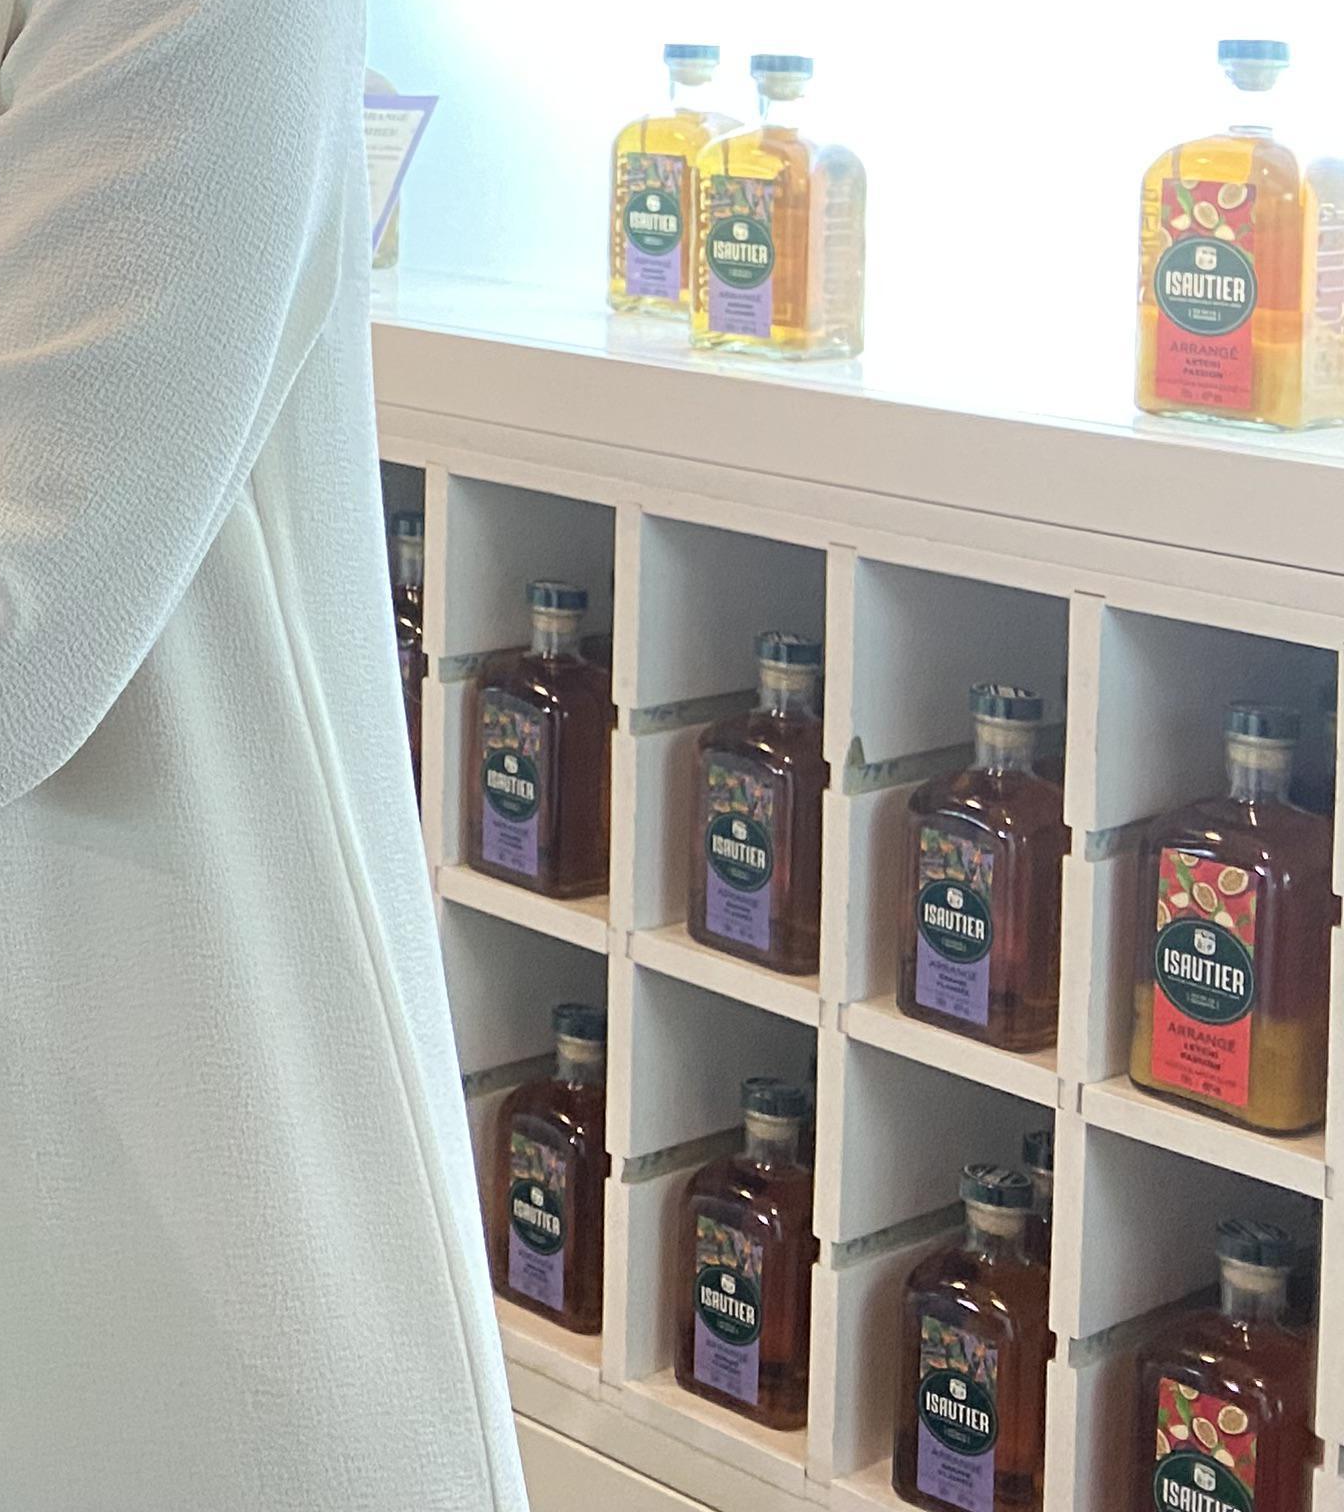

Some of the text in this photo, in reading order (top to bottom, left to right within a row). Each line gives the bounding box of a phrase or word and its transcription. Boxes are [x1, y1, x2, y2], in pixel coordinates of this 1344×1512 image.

[713, 240, 769, 264] ISAUTIER
[1165, 270, 1246, 303] ISAUTIER
[712, 832, 766, 869] ISAUTIER
[924, 902, 985, 940] ISAUTIER
[1164, 948, 1244, 996] ISAUTIER
[700, 1285, 756, 1326] ISAUTIER
[926, 1391, 989, 1434] ISAUTIER
